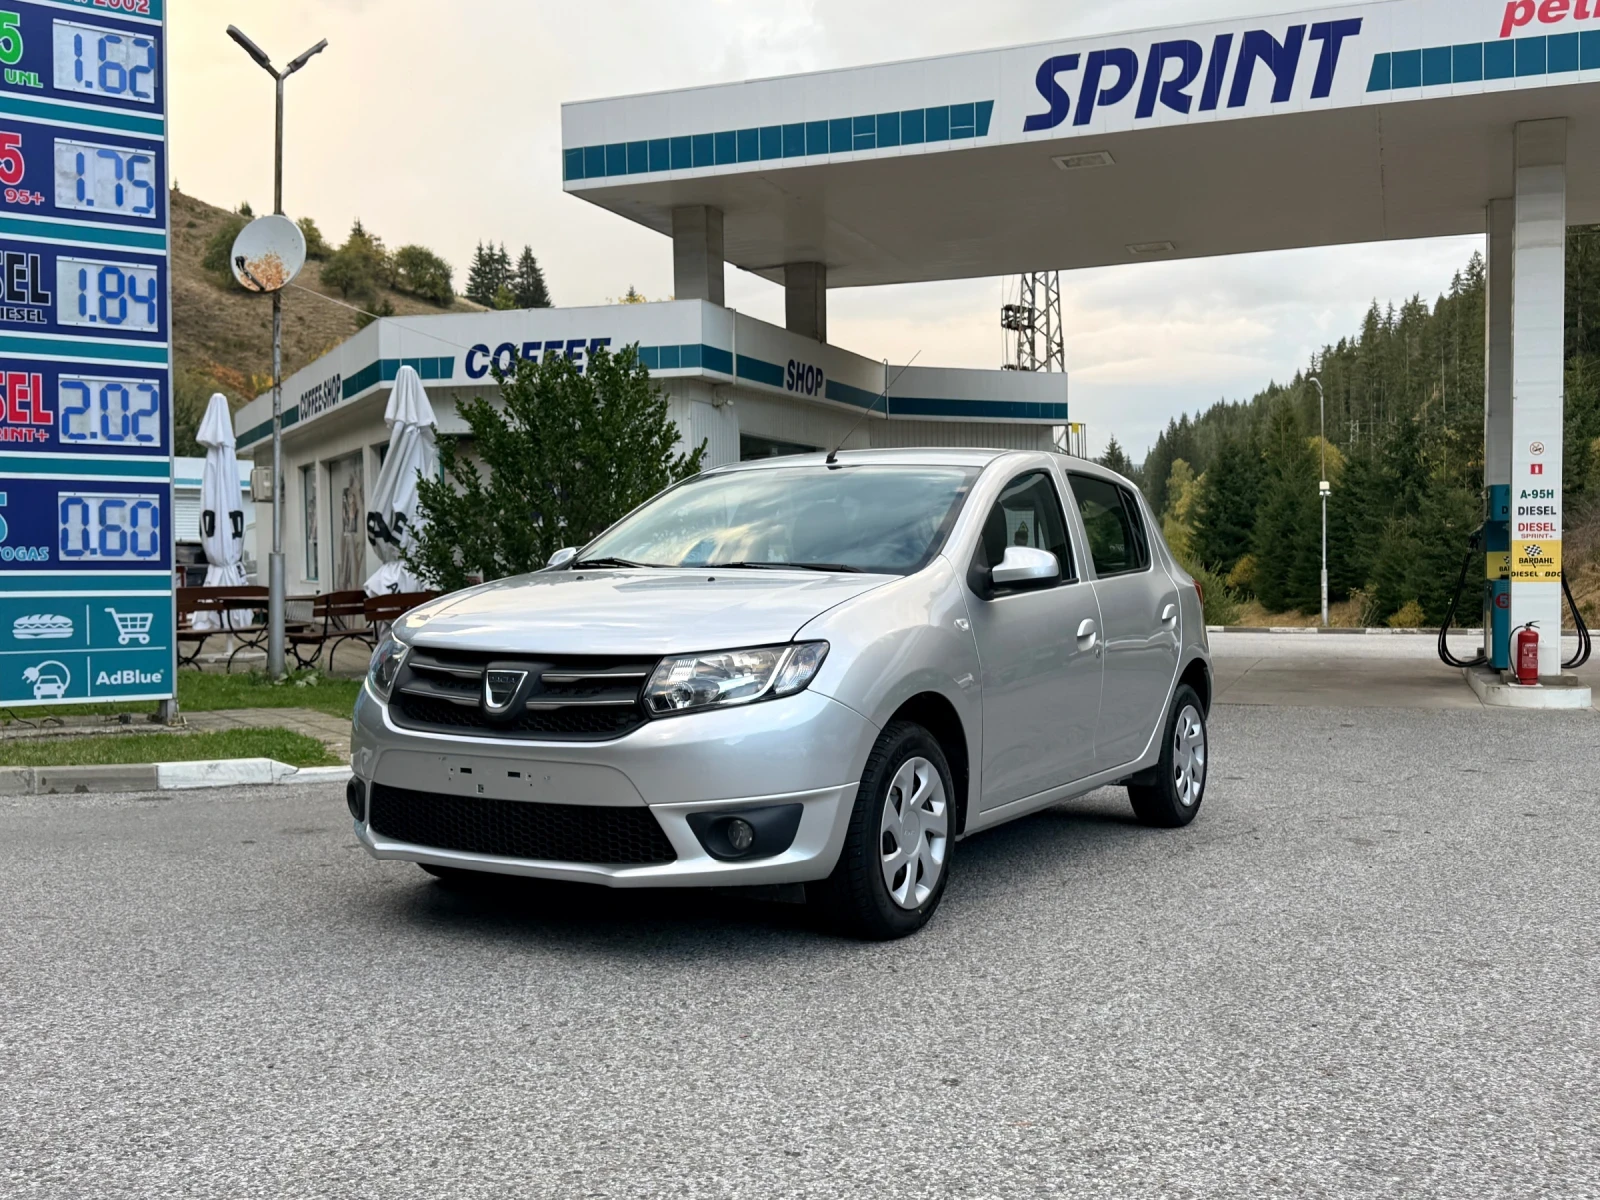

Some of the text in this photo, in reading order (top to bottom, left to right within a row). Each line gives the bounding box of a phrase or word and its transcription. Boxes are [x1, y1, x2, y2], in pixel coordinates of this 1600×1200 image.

[4, 68, 43, 88] UNL
[74, 33, 156, 98] 1.62
[1022, 17, 1363, 132] SPRINT
[4, 188, 45, 205] 95+
[76, 150, 154, 214] 1.75
[0, 250, 51, 306] EL
[78, 266, 156, 324] 1.84
[0, 371, 53, 425] EL
[787, 359, 823, 397] SHOP
[60, 381, 159, 442] 2.02
[1517, 506, 1556, 515] DIESEL
[1520, 489, 1554, 499] A-95H
[0, 546, 49, 561] OGAS
[61, 497, 159, 557] 0.60
[1517, 522, 1556, 532] DIESEL
